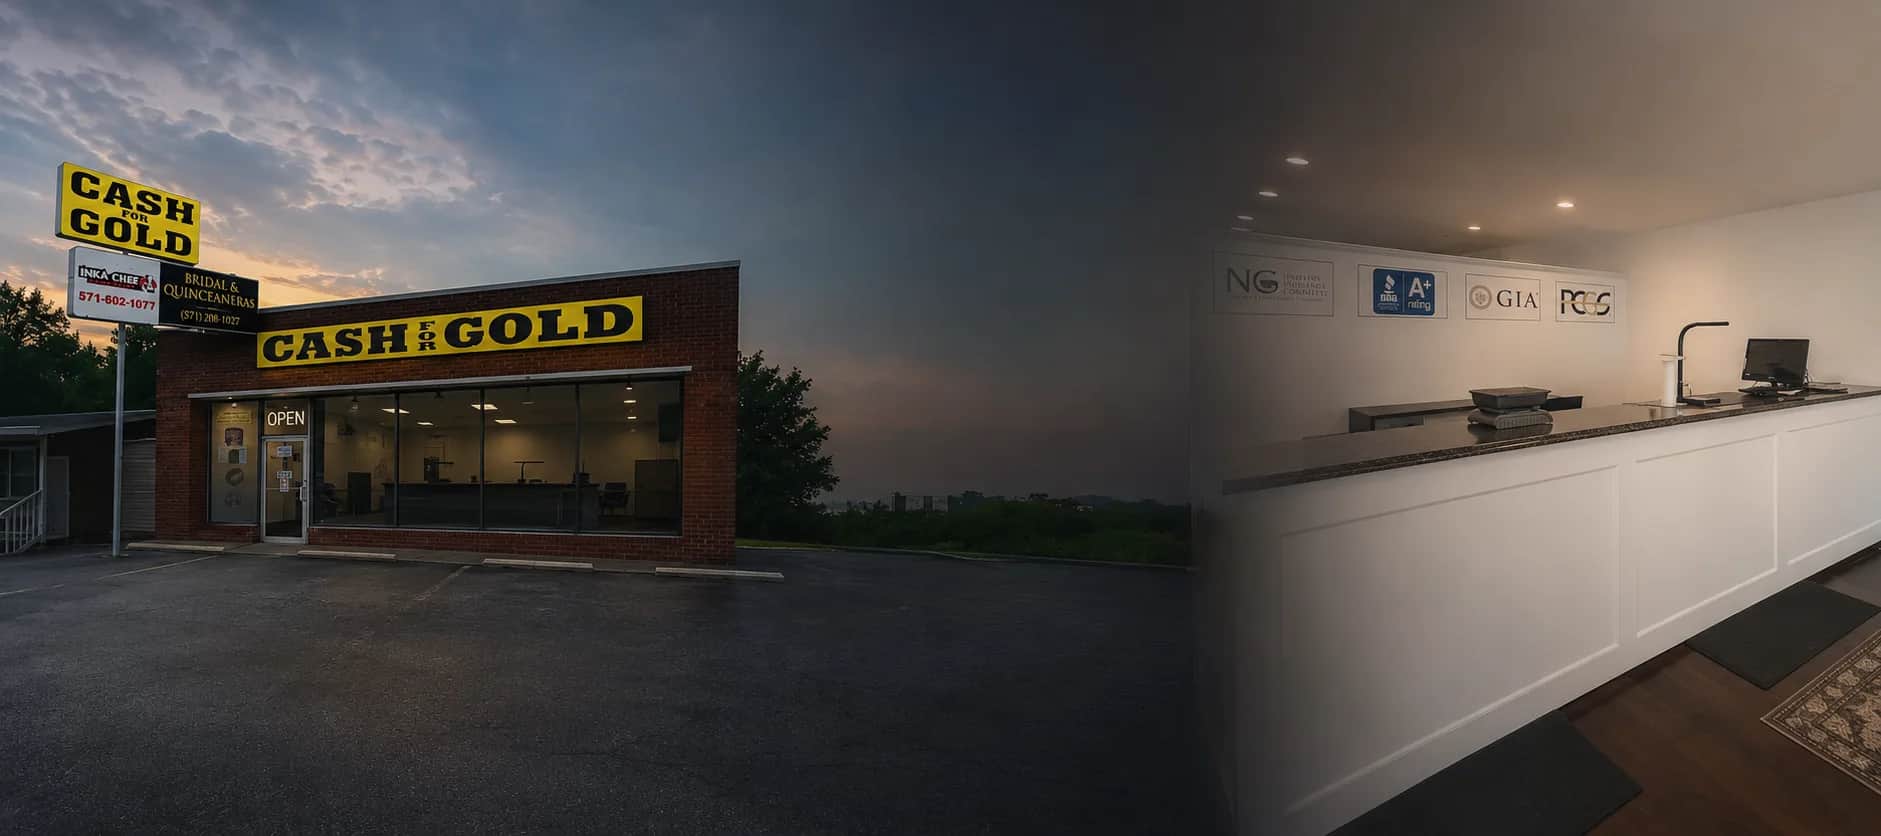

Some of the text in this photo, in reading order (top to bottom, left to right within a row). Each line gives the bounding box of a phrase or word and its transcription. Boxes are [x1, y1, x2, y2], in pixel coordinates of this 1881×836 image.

[71, 171, 194, 225] CASH
[122, 209, 149, 224] FOR
[70, 208, 192, 256] GOLD
[80, 267, 108, 281] INKA
[185, 272, 239, 293] BRIDAL &
[1226, 268, 1279, 294] NG
[163, 283, 255, 308] QUINCEANERAS
[1408, 277, 1432, 298] A+
[79, 291, 156, 310] 571-602-1077
[1496, 290, 1538, 308] GIA
[180, 310, 202, 322] (571)
[262, 303, 635, 363] CASH FOR GOLD
[267, 410, 305, 427] OPEN
